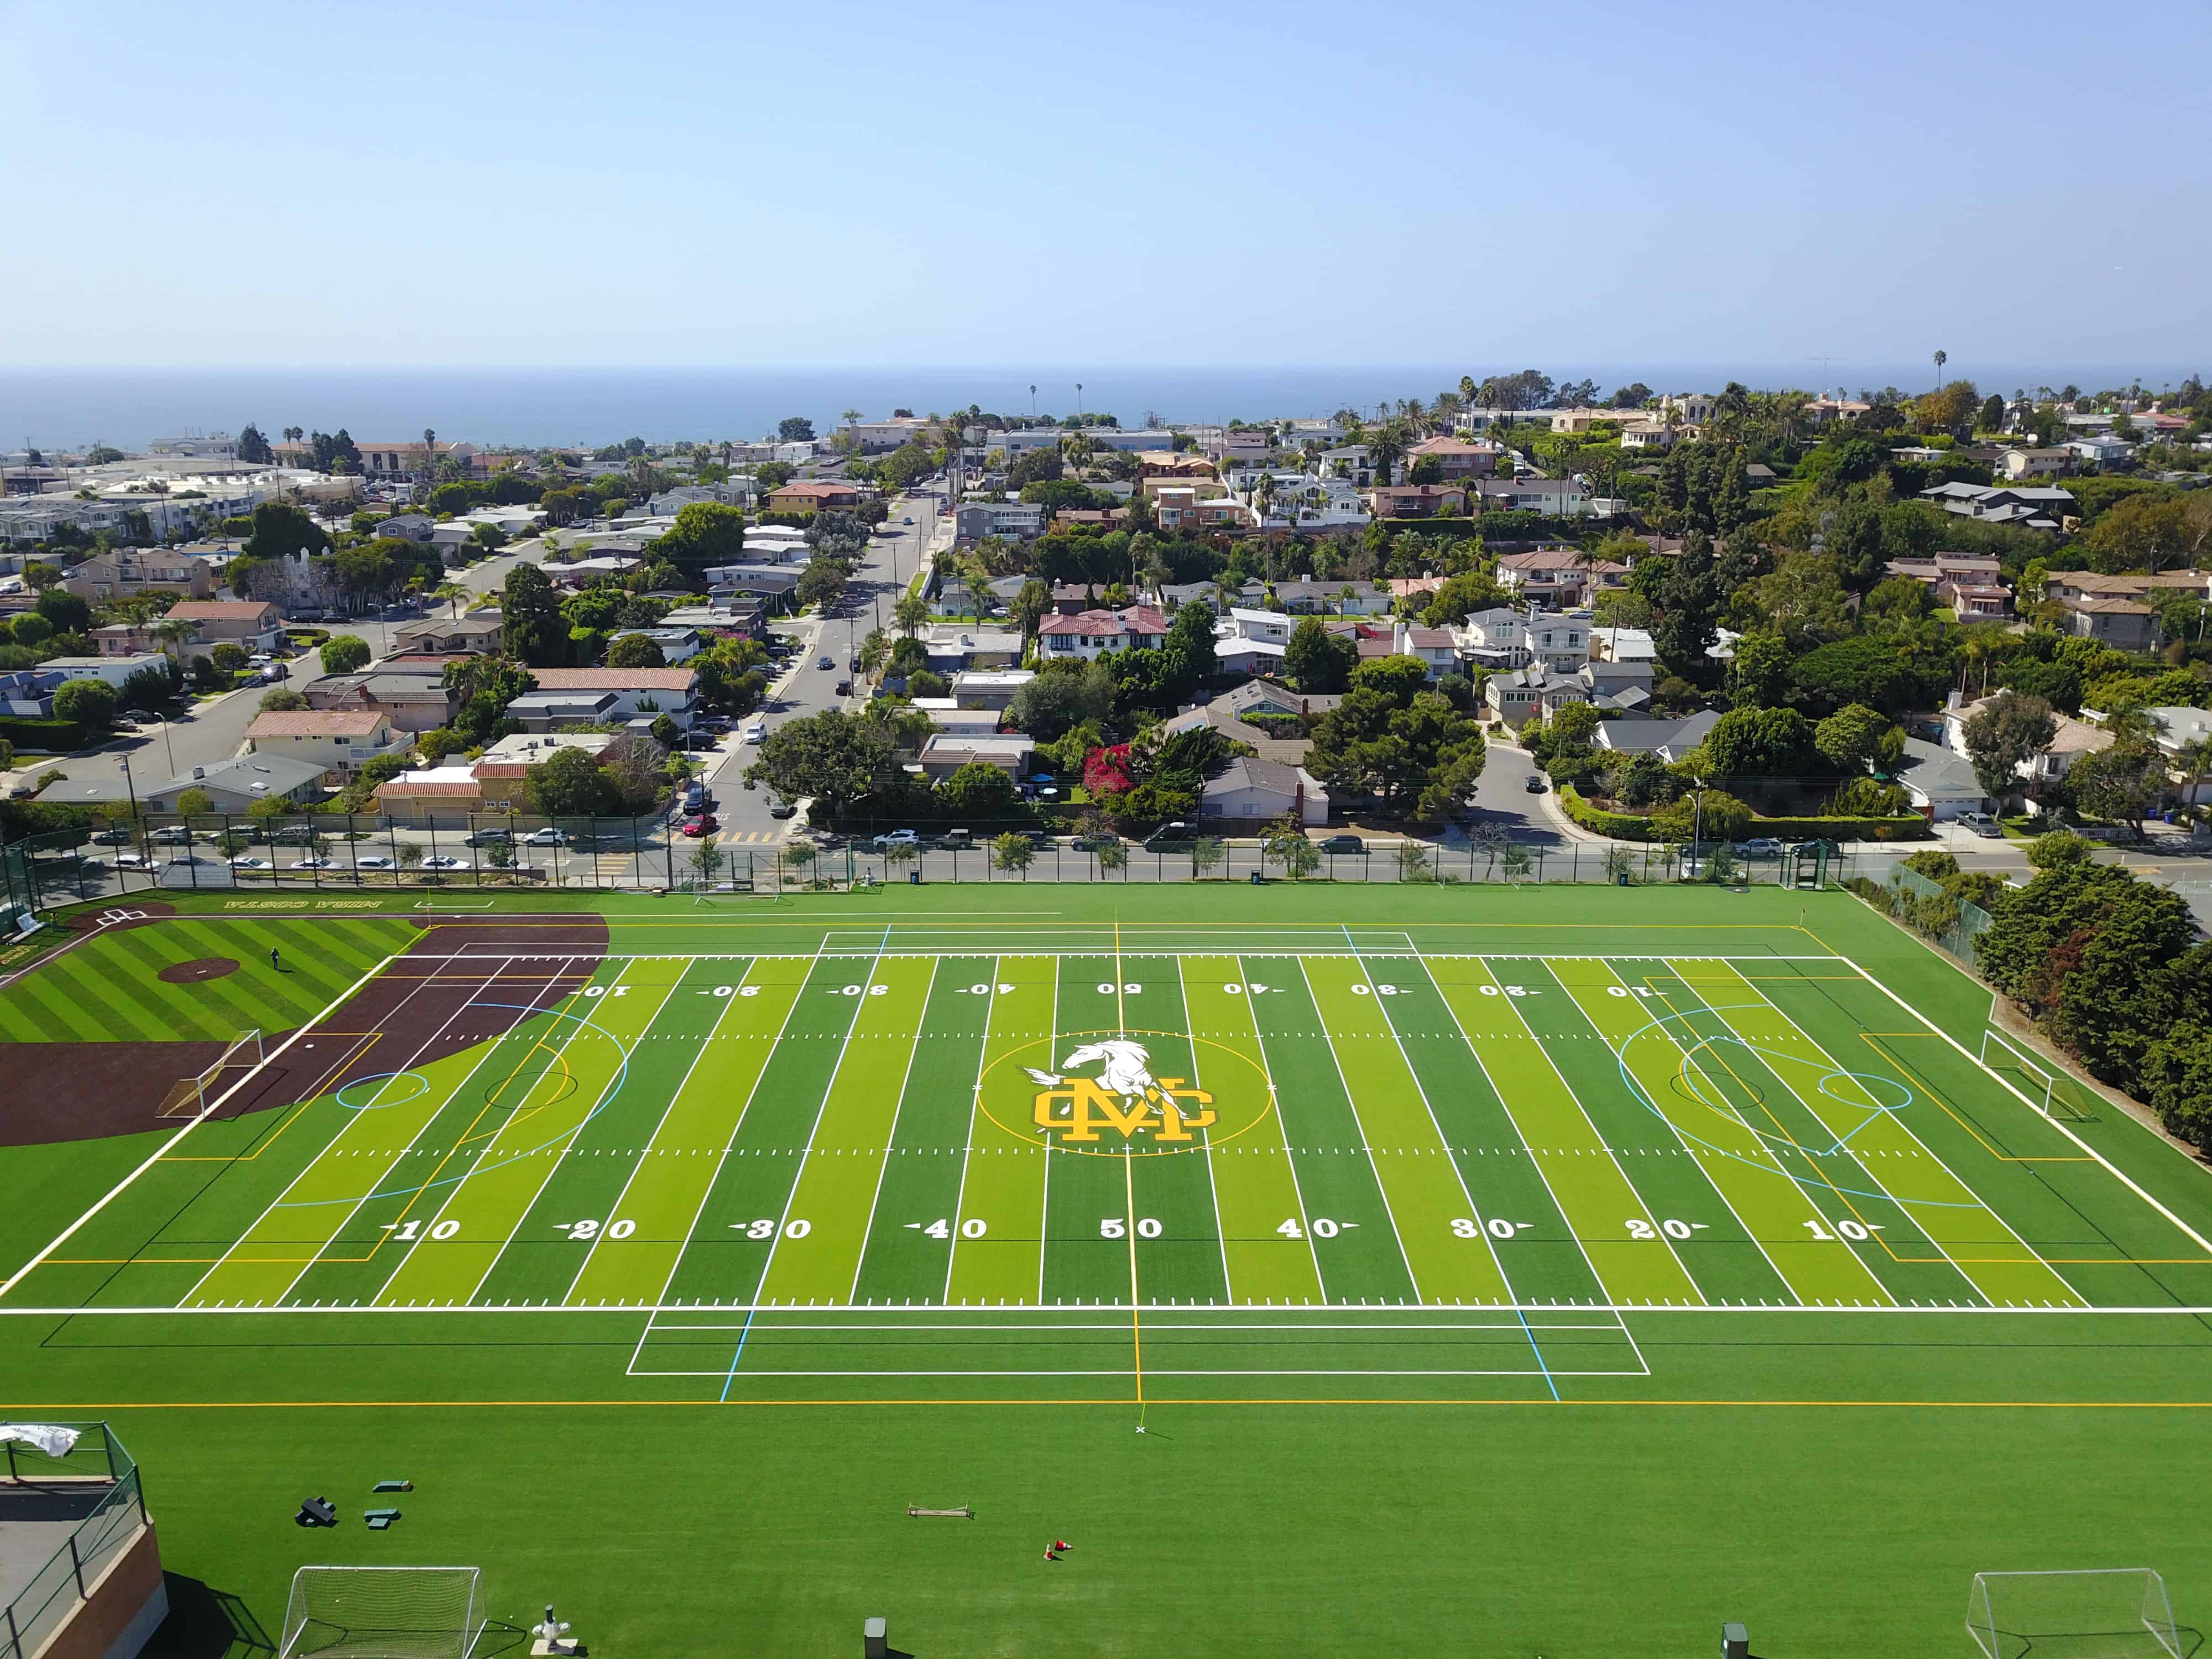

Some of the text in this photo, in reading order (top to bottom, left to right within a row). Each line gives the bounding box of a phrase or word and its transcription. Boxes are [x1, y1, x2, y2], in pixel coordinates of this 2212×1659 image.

[393, 1220, 461, 1240] 10
[567, 1220, 636, 1239] 20
[747, 1219, 811, 1239] 30
[924, 1219, 987, 1238] 40
[1100, 1218, 1162, 1238] 50
[1276, 1218, 1339, 1238] 40
[1450, 1219, 1514, 1238] 30
[1625, 1219, 1691, 1239] 20
[1802, 1220, 1869, 1240] 10
